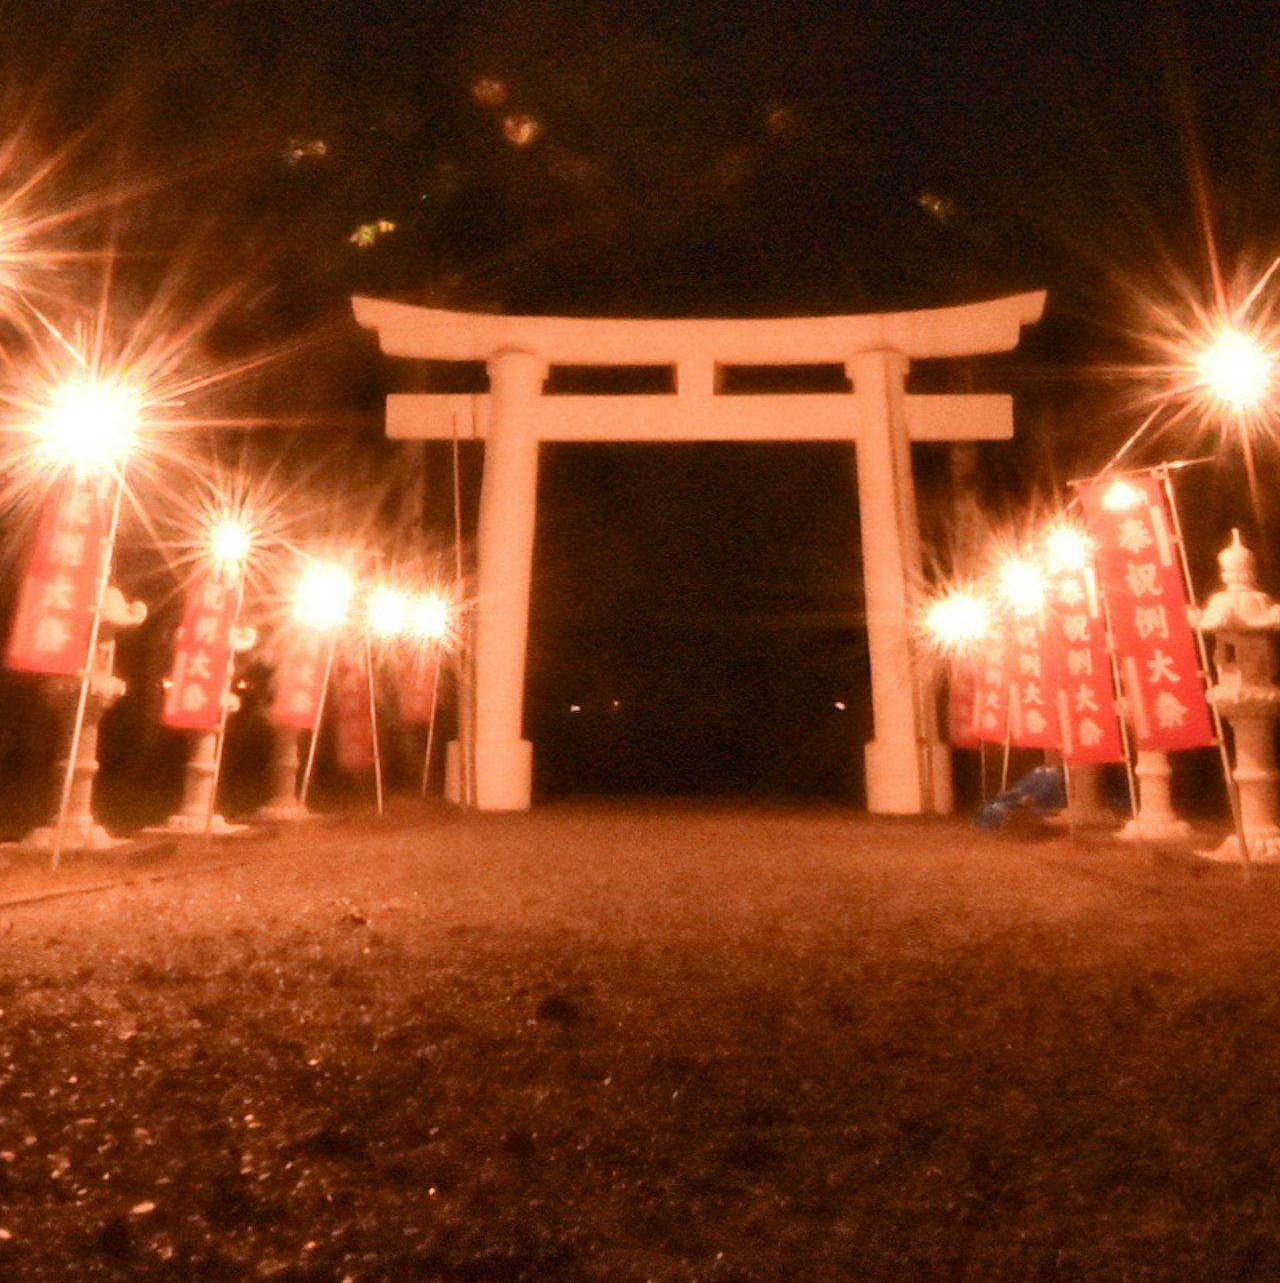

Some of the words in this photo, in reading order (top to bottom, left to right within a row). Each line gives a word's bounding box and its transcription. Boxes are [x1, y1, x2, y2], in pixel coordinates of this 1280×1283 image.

[1117, 518, 1189, 730] 奉祝例大祭
